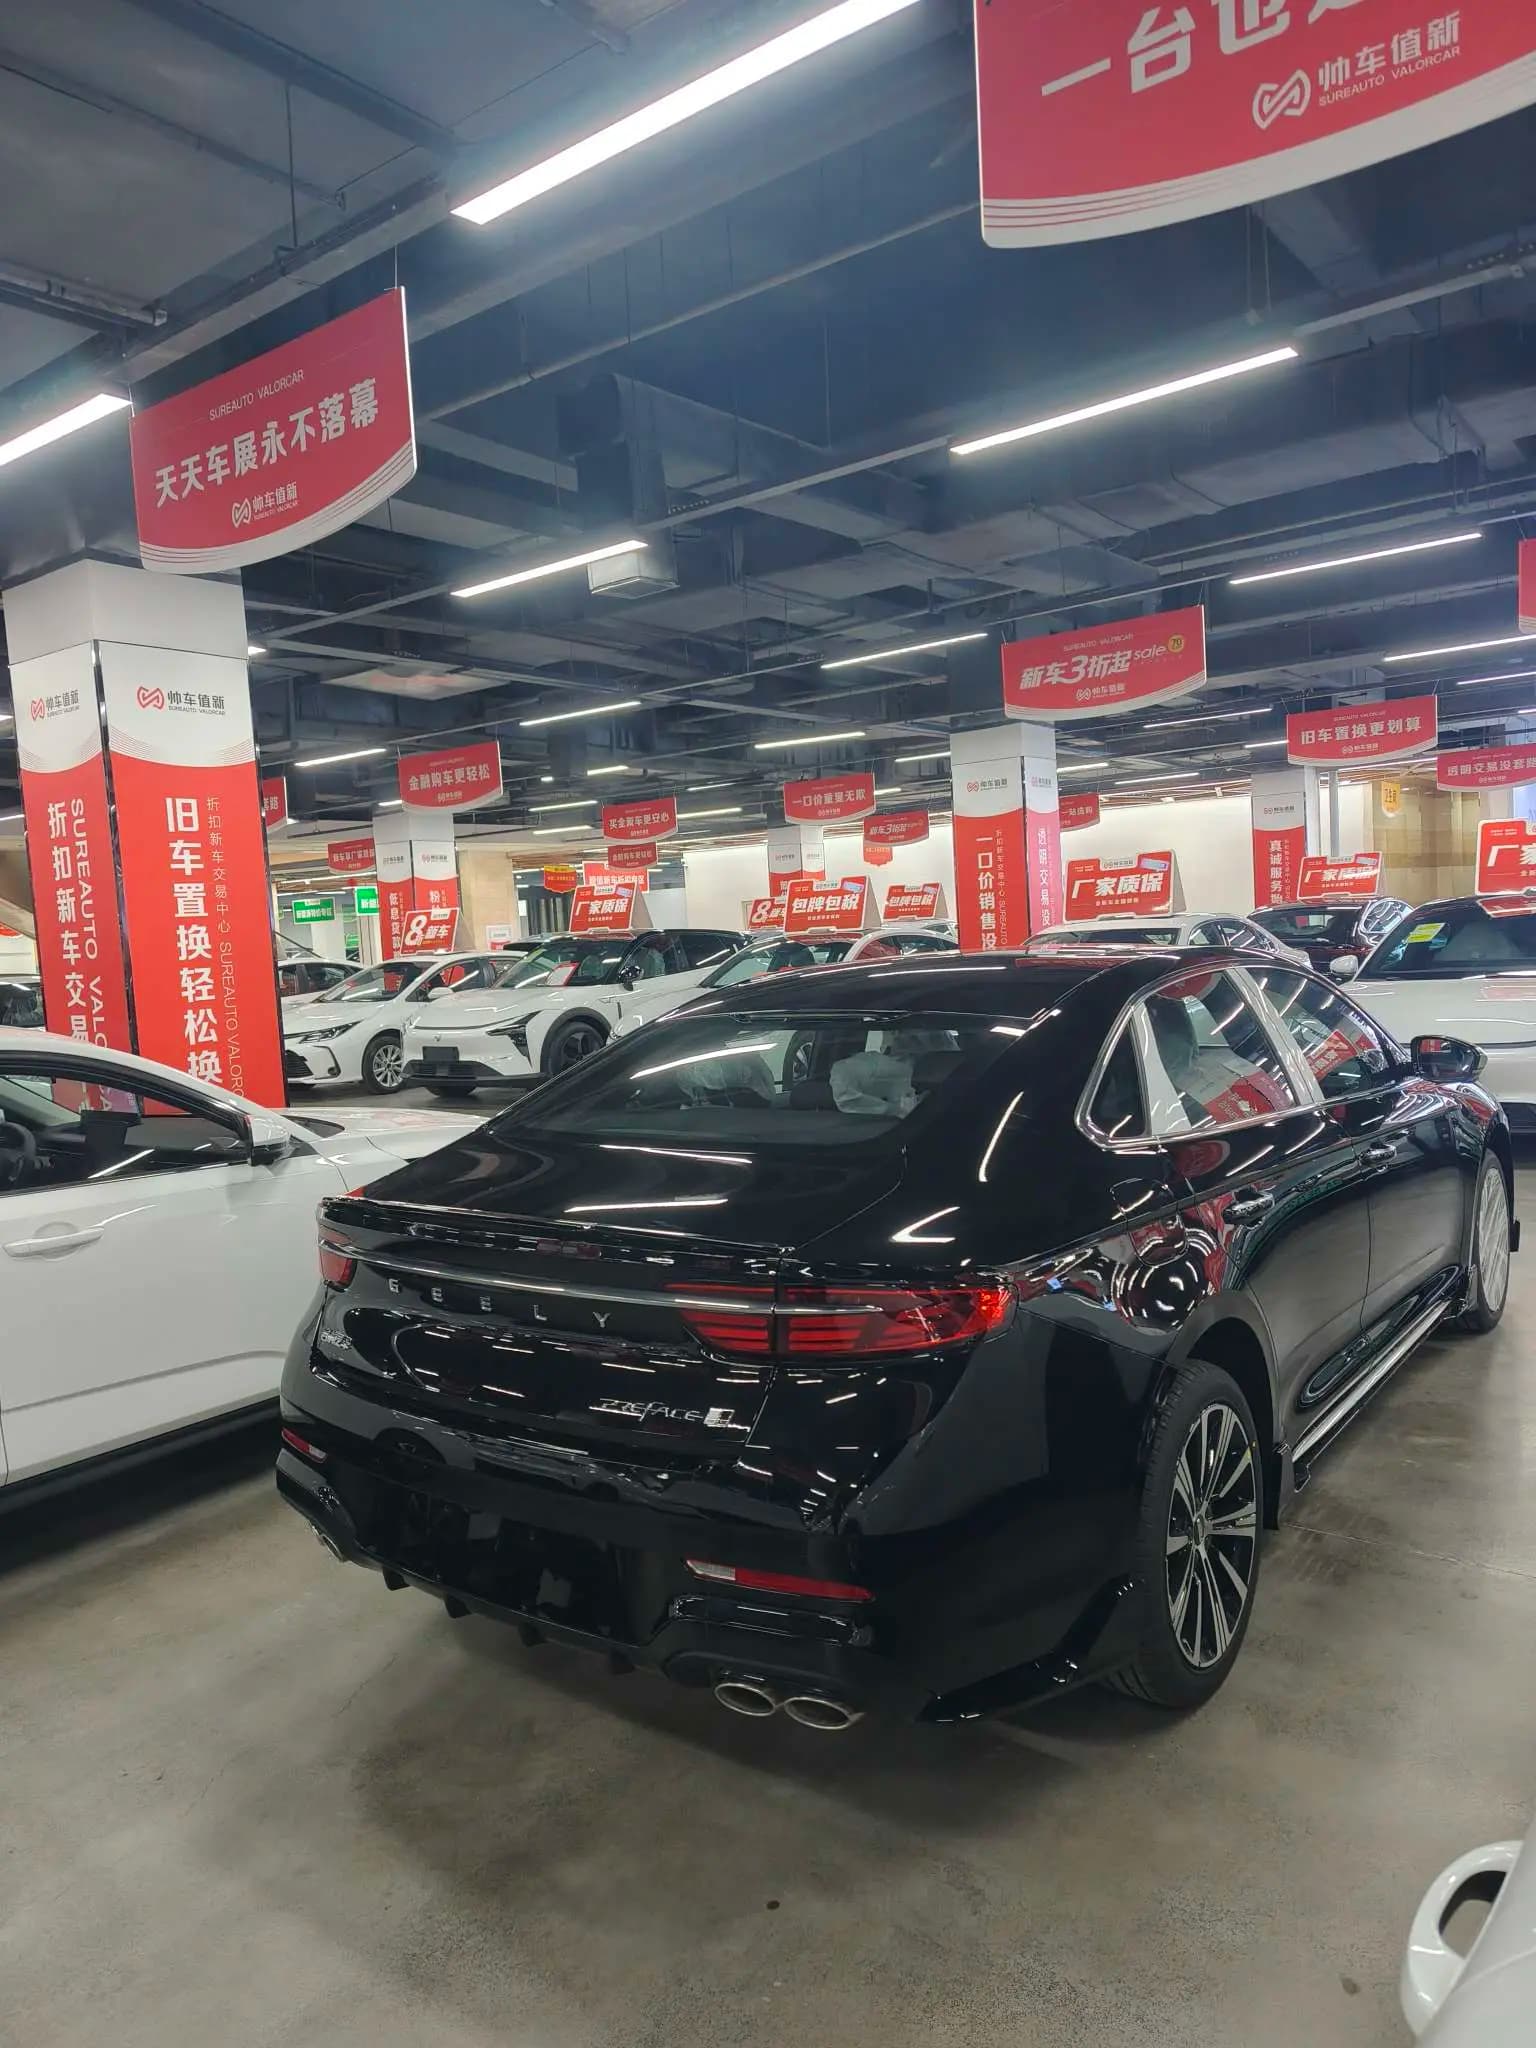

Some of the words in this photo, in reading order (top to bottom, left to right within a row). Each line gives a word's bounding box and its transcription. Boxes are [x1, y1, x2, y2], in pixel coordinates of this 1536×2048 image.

[1042, 0, 1364, 94] 一台也
[1317, 11, 1461, 91] 帅车值新
[1318, 74, 1386, 106] SUREAUTO
[1390, 45, 1461, 80] VALORCAR
[208, 392, 255, 422] SUREAUTO
[257, 369, 306, 399] VALORCAR
[154, 377, 379, 509] 天天车展永不落幕
[252, 481, 298, 512] 帅车值新
[1019, 649, 1132, 691] 新车3折起
[1133, 645, 1169, 661] sale
[166, 689, 226, 711] 帅车值新
[1300, 715, 1422, 746] 旧车置换更划算
[407, 763, 491, 791] 金融购车更轻松
[71, 798, 98, 960] SUREAUTO
[791, 893, 860, 914] 包牌包税
[1071, 872, 1165, 900] 厂家质保
[206, 797, 231, 934] 折扣新车交易中心
[219, 941, 239, 1031] SUREAUTO
[575, 898, 630, 917] 厂家质保
[165, 797, 222, 1085] 旧车置换轻松换
[388, 1277, 611, 1328] GEELY
